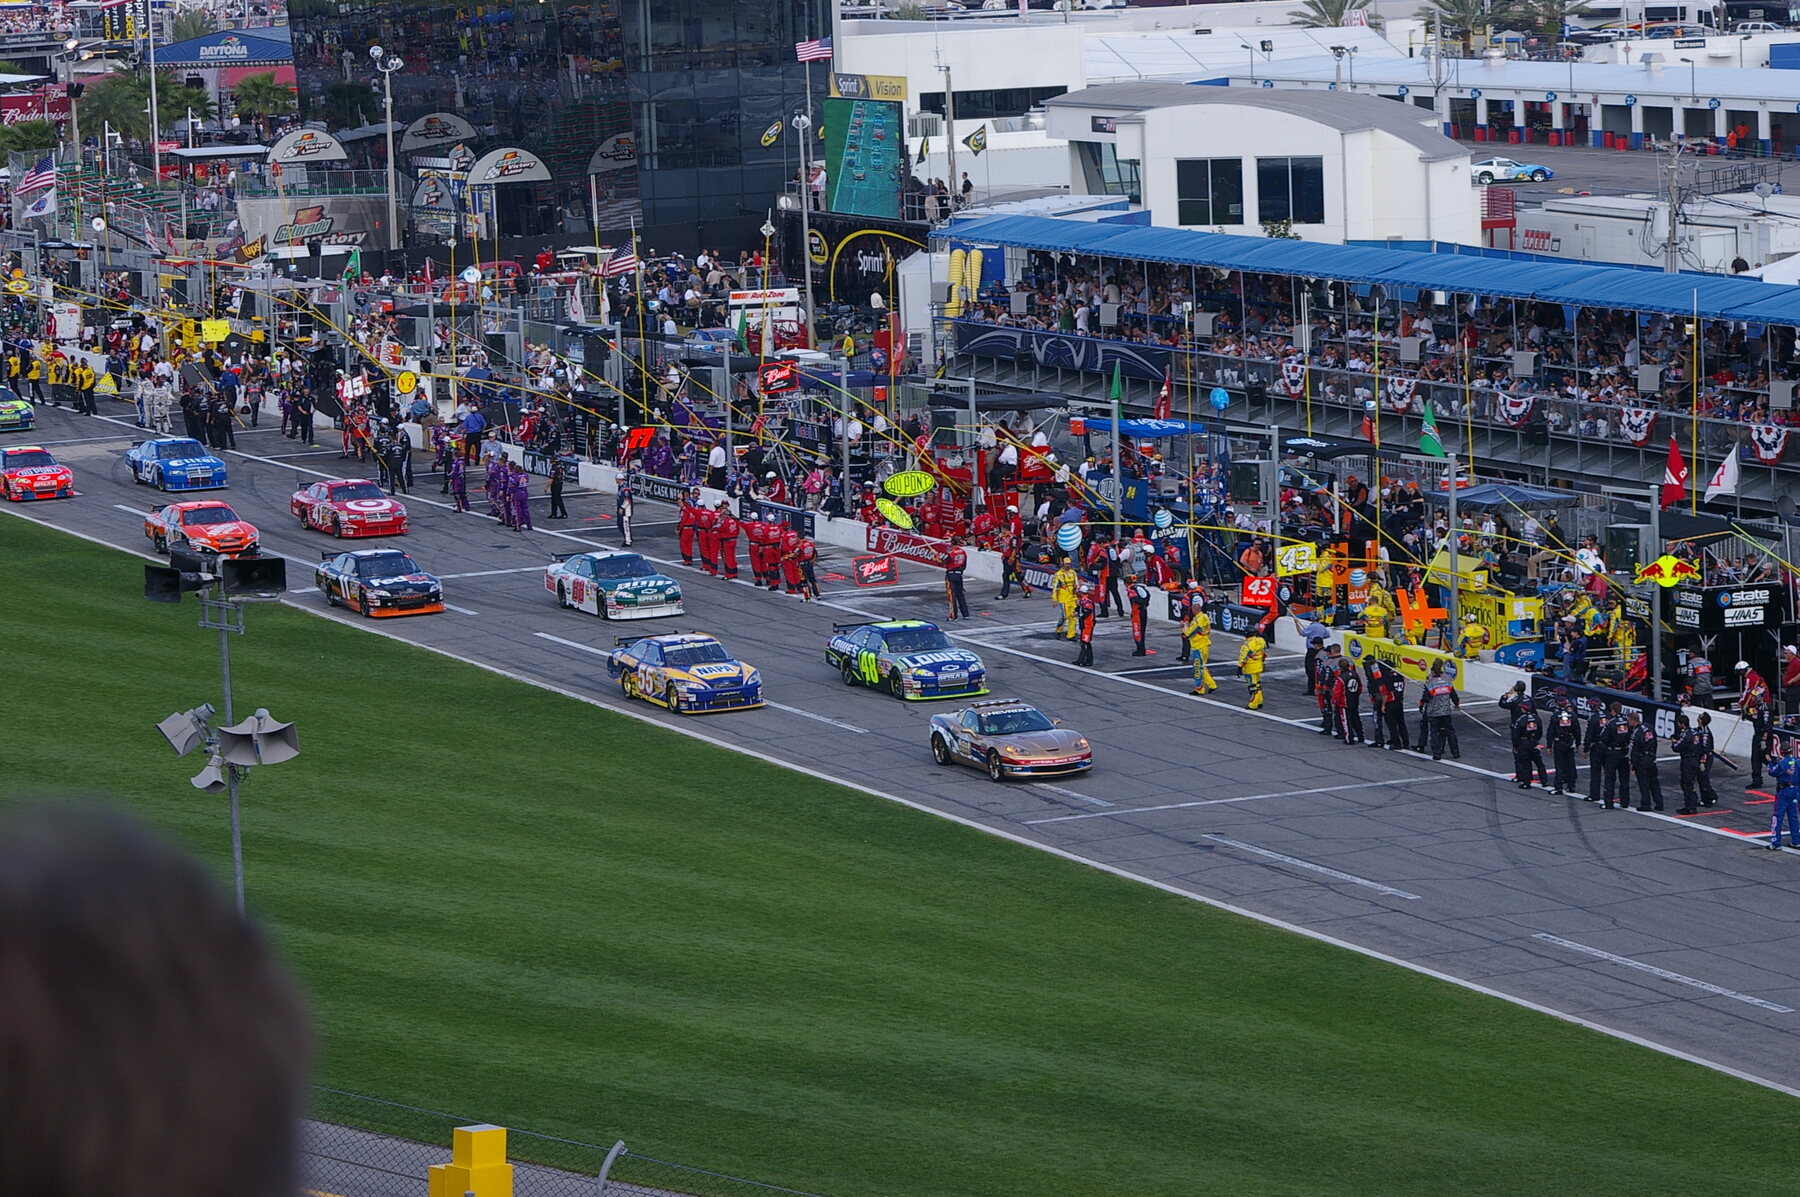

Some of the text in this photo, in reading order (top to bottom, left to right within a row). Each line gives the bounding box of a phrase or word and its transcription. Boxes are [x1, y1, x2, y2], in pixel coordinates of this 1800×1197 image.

[199, 45, 248, 56] DAYTONA
[838, 77, 902, 96] Sprint Vision
[1626, 96, 1634, 104] 22
[1709, 99, 1718, 108] 20
[275, 219, 332, 241] Gatorade
[857, 249, 884, 277] Sprint
[628, 427, 655, 449] 77
[653, 484, 669, 499] CASK
[904, 473, 929, 492] PONT
[1280, 545, 1312, 572] 43
[859, 558, 889, 578] Bud
[370, 574, 429, 587] FedEx
[1247, 578, 1272, 596] 43
[1348, 588, 1368, 601] at&t
[1732, 589, 1770, 602] state
[1232, 614, 1250, 631] at&t
[1457, 602, 1493, 627] heerios
[1731, 608, 1760, 621] HAAS
[695, 664, 734, 676] NAPA
[860, 651, 879, 686] 48
[637, 663, 655, 695] 55
[980, 707, 1037, 718] CHEVROLET
[1654, 708, 1676, 739] 66
